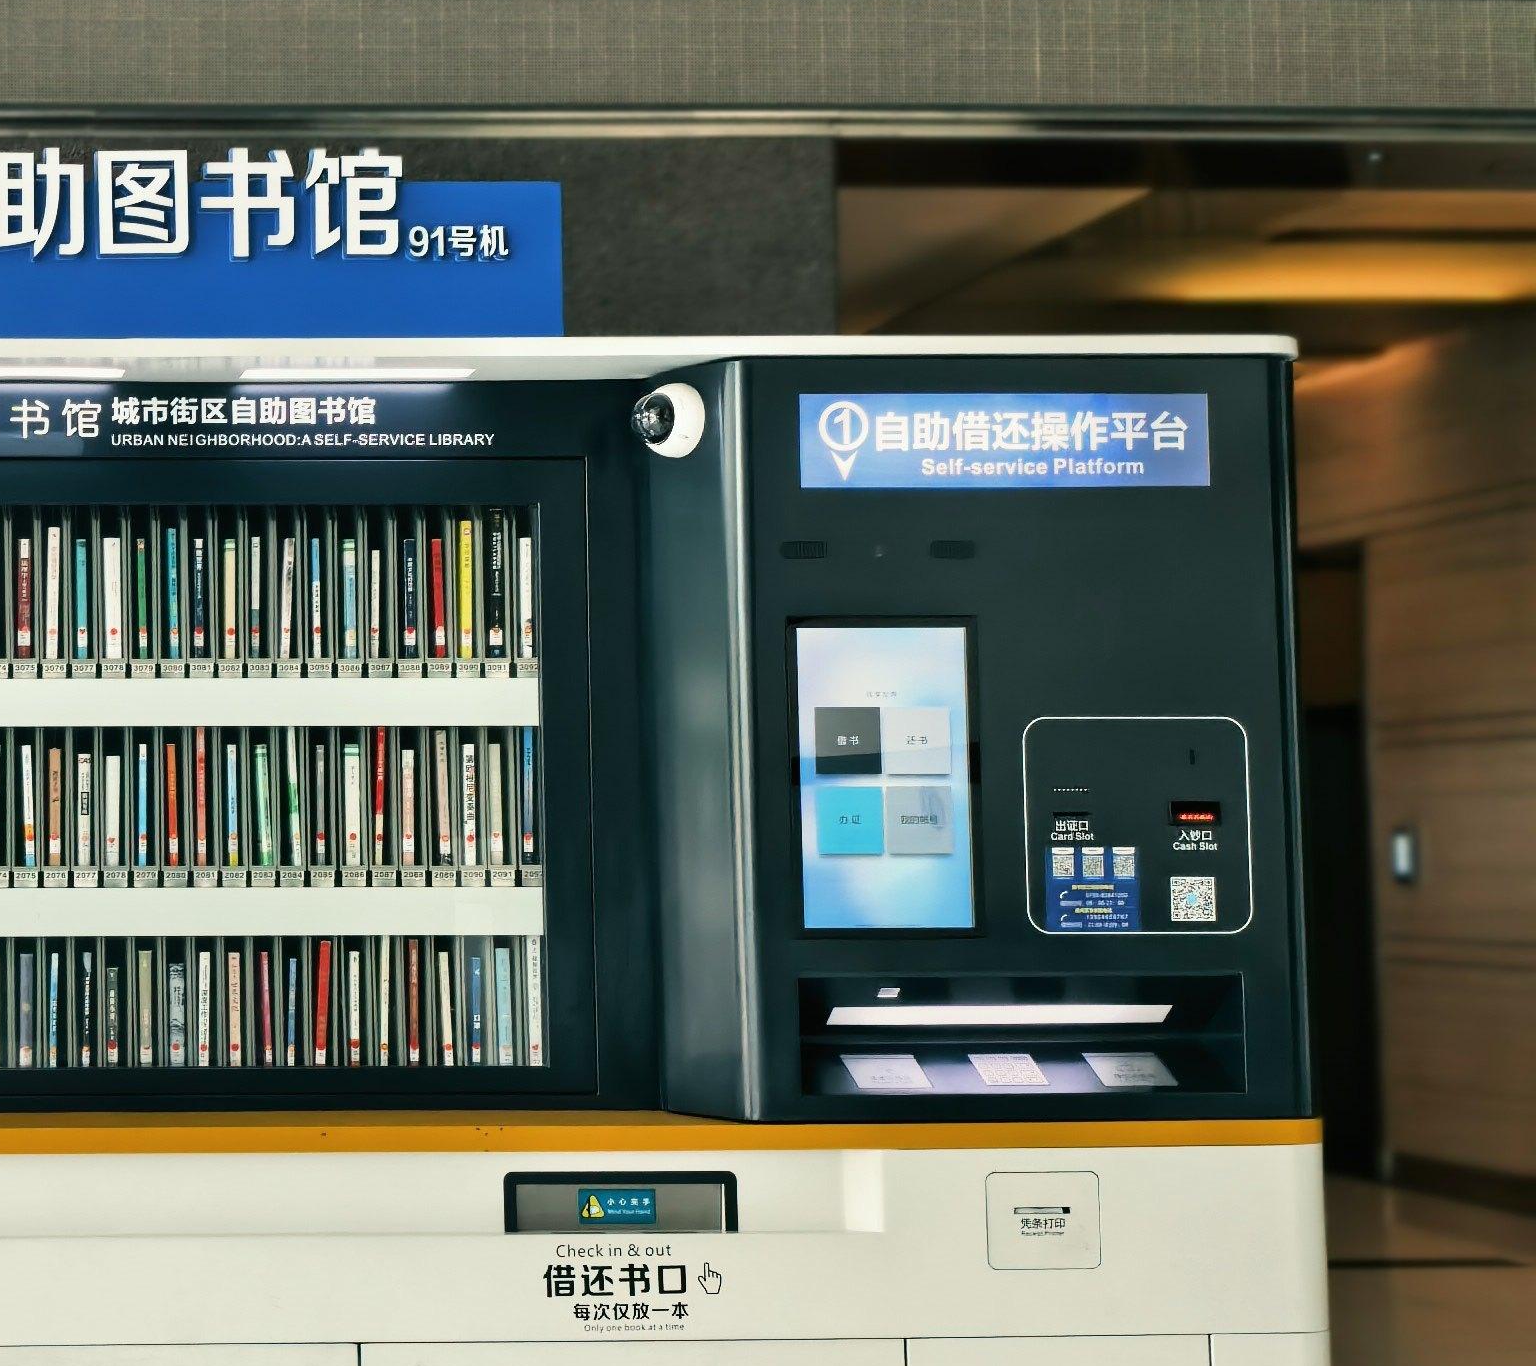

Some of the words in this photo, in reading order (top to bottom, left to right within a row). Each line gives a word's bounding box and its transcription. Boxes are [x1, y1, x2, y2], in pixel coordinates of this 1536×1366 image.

[409, 222, 509, 261] 91号机
[111, 396, 376, 425] 城市街区自助图书馆
[875, 410, 1187, 452] 自助借还操作平台
[112, 433, 164, 447] URBAN
[314, 433, 426, 447] SELF-SERVICE
[430, 433, 496, 447] LIBRARY
[921, 457, 1048, 476] Self-service
[1054, 457, 1145, 476] Platform
[1055, 820, 1089, 831] 出证口
[1050, 832, 1073, 841] Card
[1075, 832, 1094, 841] Slot
[1173, 842, 1197, 851] Cash
[1199, 842, 1218, 851] Slot
[556, 1244, 603, 1257] Check
[608, 1243, 622, 1257] in
[627, 1243, 641, 1257] &
[645, 1244, 672, 1257] out
[543, 1263, 687, 1297] 借还书口
[573, 1302, 689, 1321] 每次仅放一本
[584, 1324, 604, 1333] Only
[606, 1324, 622, 1332] one
[624, 1323, 646, 1332] book
[665, 1323, 685, 1331] time
